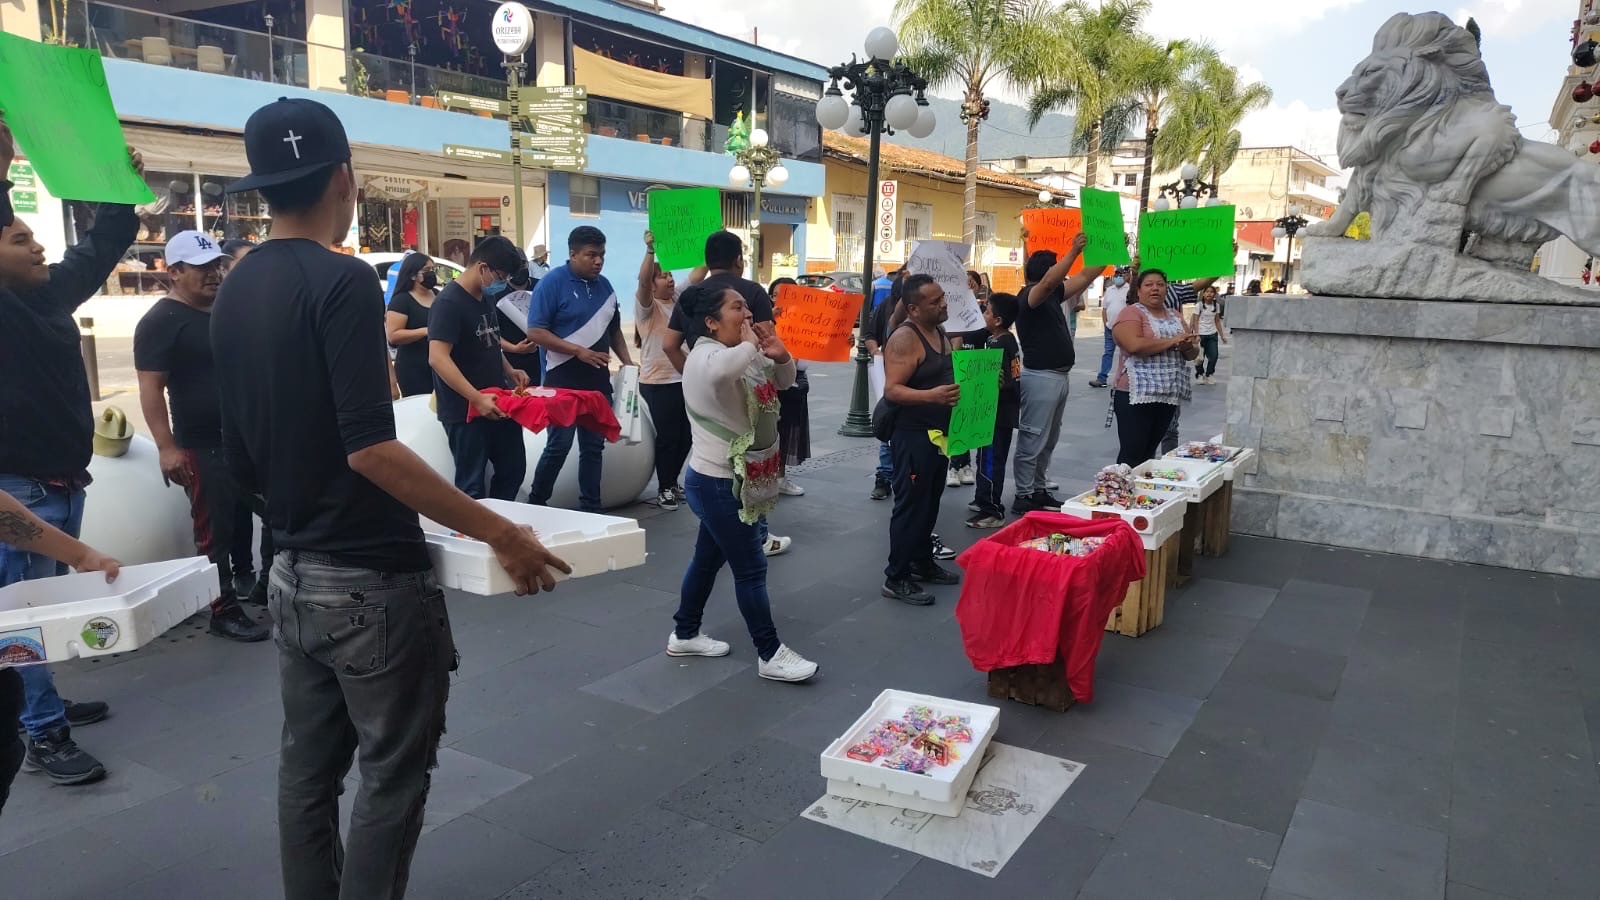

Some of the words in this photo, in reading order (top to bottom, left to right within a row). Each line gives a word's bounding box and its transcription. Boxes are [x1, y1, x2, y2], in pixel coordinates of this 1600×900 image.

[383, 176, 411, 185] Centro
[628, 191, 649, 209] VF
[1147, 213, 1187, 229] Vender
[194, 236, 213, 249] LA
[1147, 242, 1207, 265] negocio
